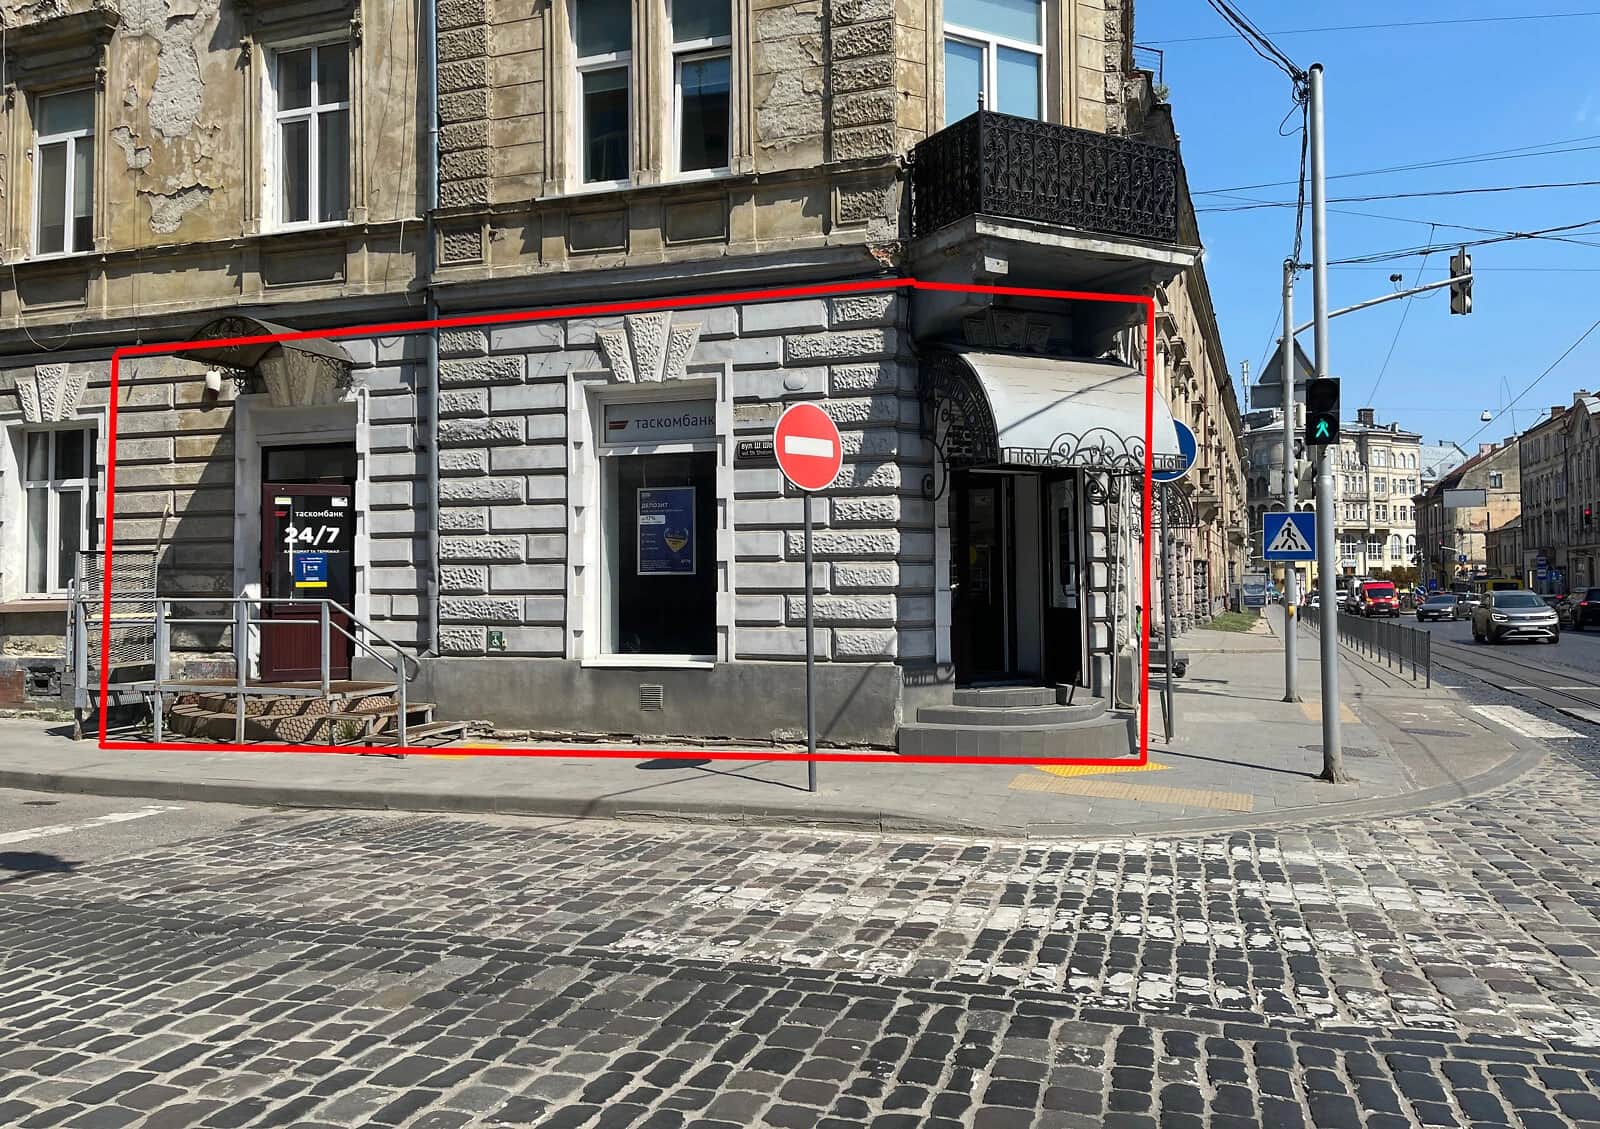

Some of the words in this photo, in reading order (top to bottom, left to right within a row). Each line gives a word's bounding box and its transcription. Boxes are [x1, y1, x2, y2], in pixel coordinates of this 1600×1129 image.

[635, 413, 714, 429] таскомбанк
[295, 509, 344, 518] таскомбанк
[284, 525, 340, 546] 24/7
